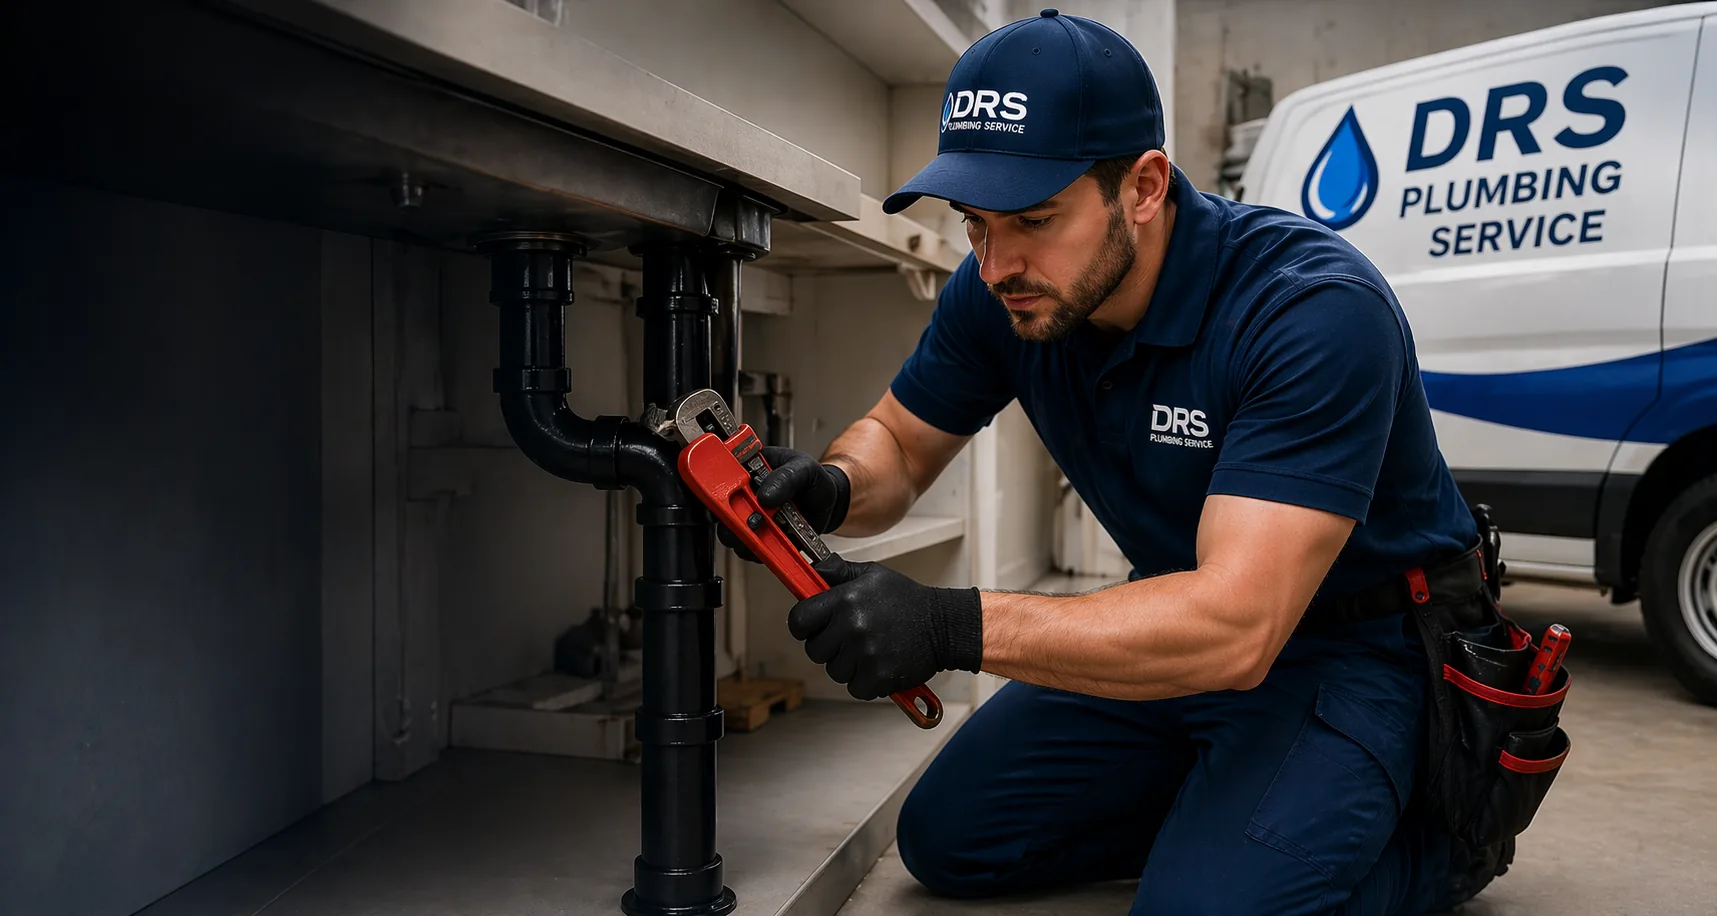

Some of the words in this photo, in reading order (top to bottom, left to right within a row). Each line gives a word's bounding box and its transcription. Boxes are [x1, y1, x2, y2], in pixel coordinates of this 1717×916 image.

[952, 89, 1028, 121] DRS
[1405, 65, 1629, 172] DRS
[983, 121, 1025, 134] SERVICE
[1400, 160, 1622, 218] PLUMBING
[1429, 209, 1606, 257] SERVICE
[1151, 404, 1209, 438] DRS
